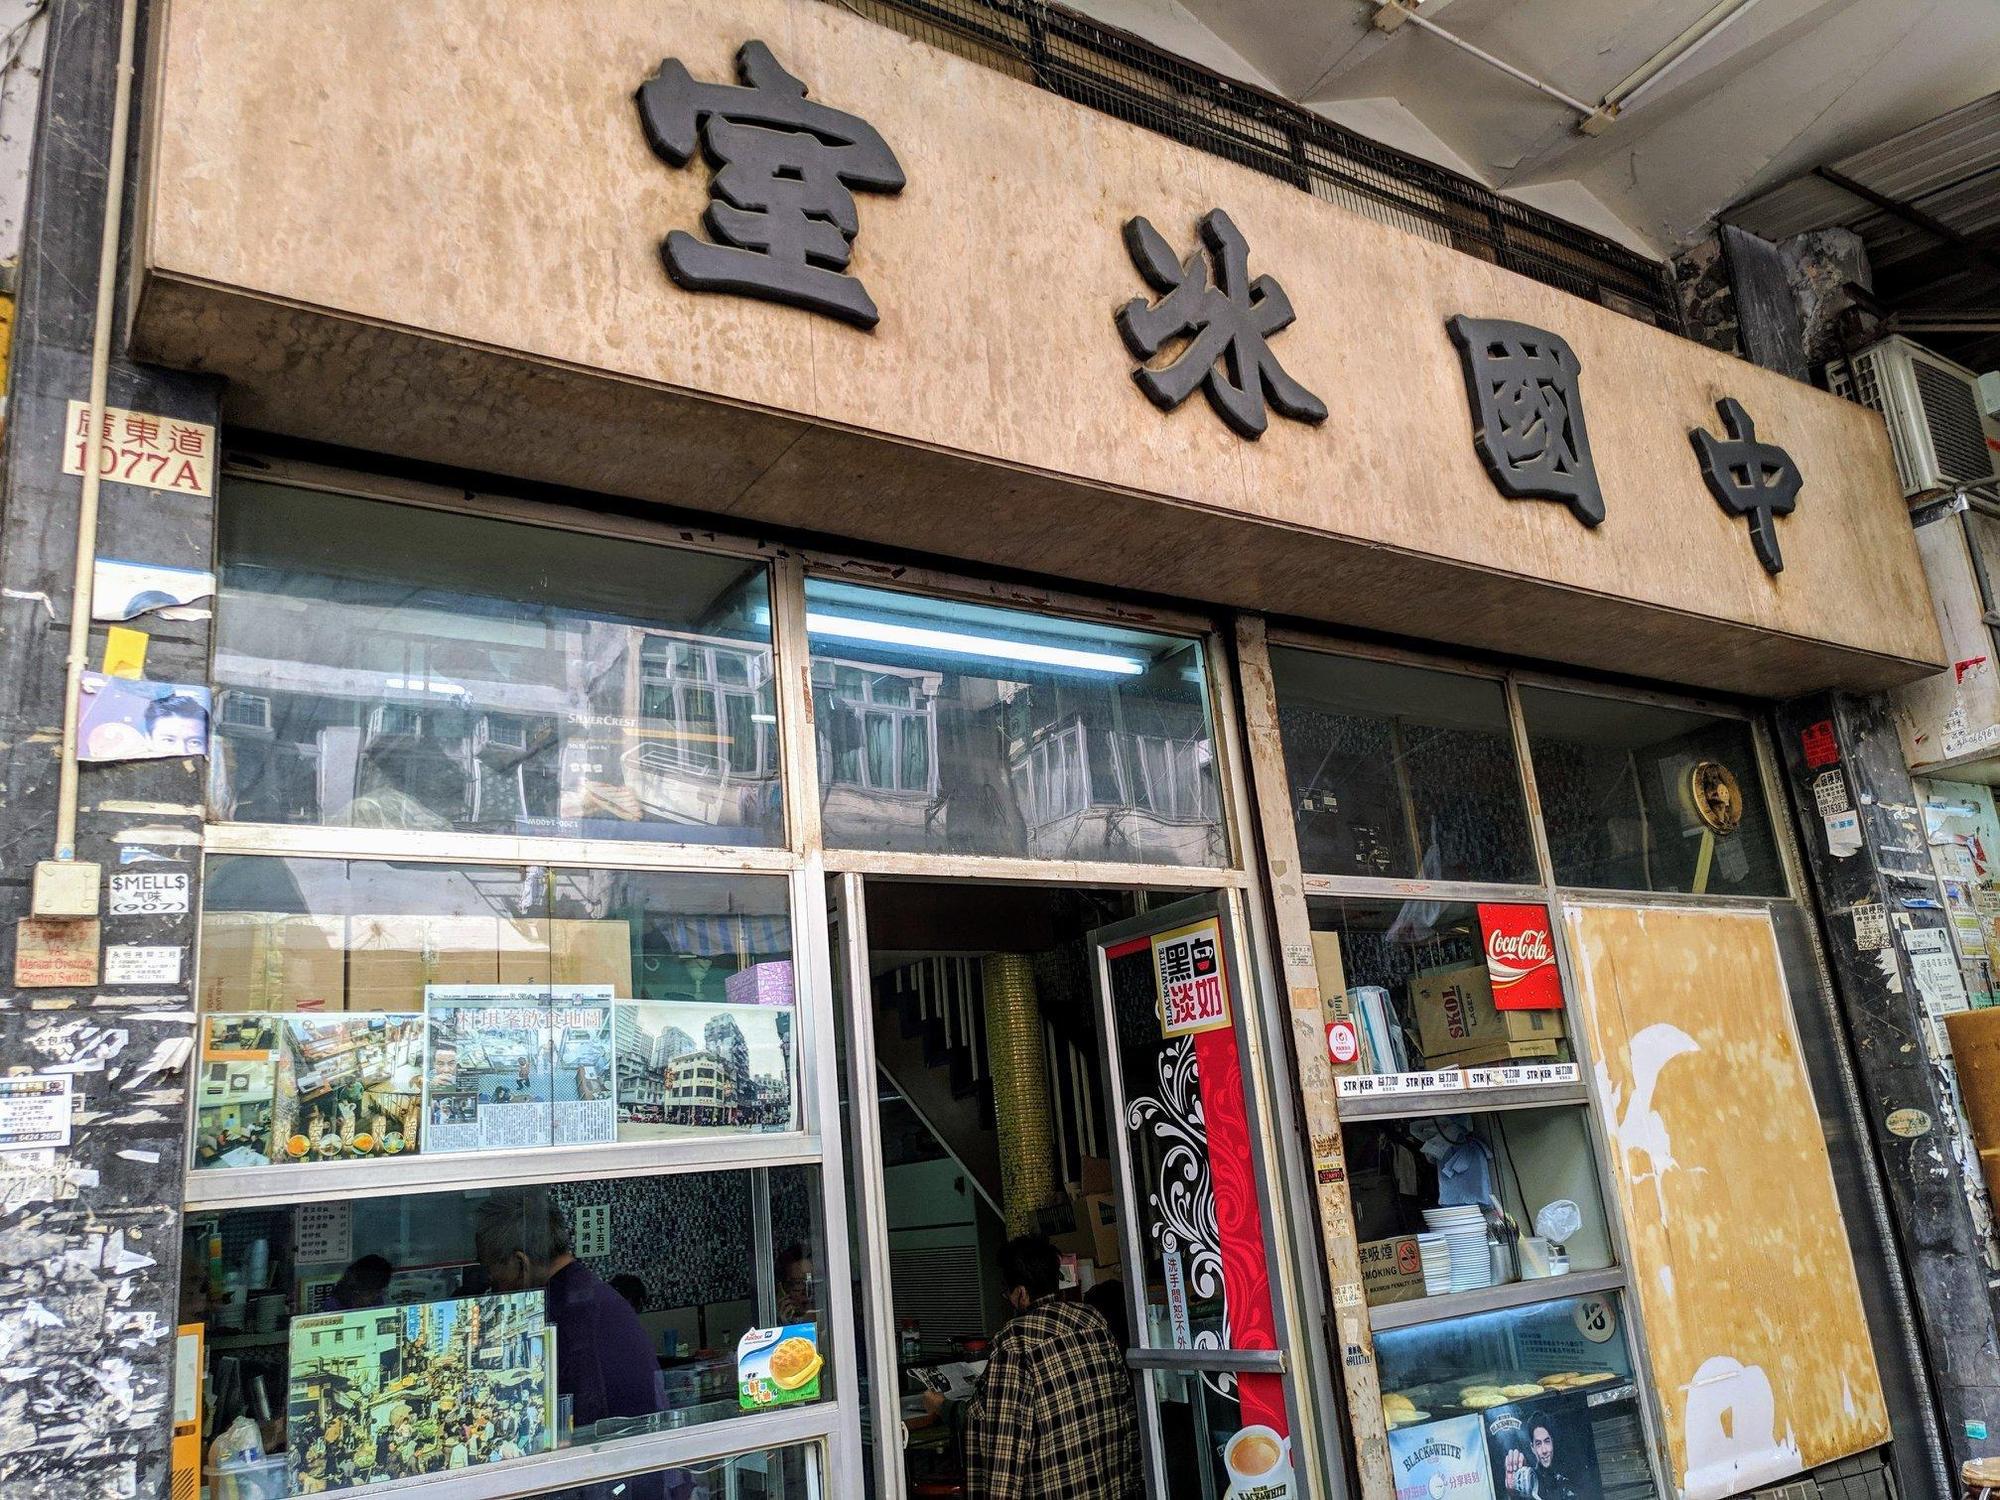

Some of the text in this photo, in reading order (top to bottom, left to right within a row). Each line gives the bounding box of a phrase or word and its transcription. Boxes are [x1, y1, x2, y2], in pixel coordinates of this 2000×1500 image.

[76, 408, 206, 459] 廣東道
[113, 902, 186, 912] (907)
[1488, 929, 1550, 961] Coca-Cola
[1170, 976, 1222, 1024] 淡奶
